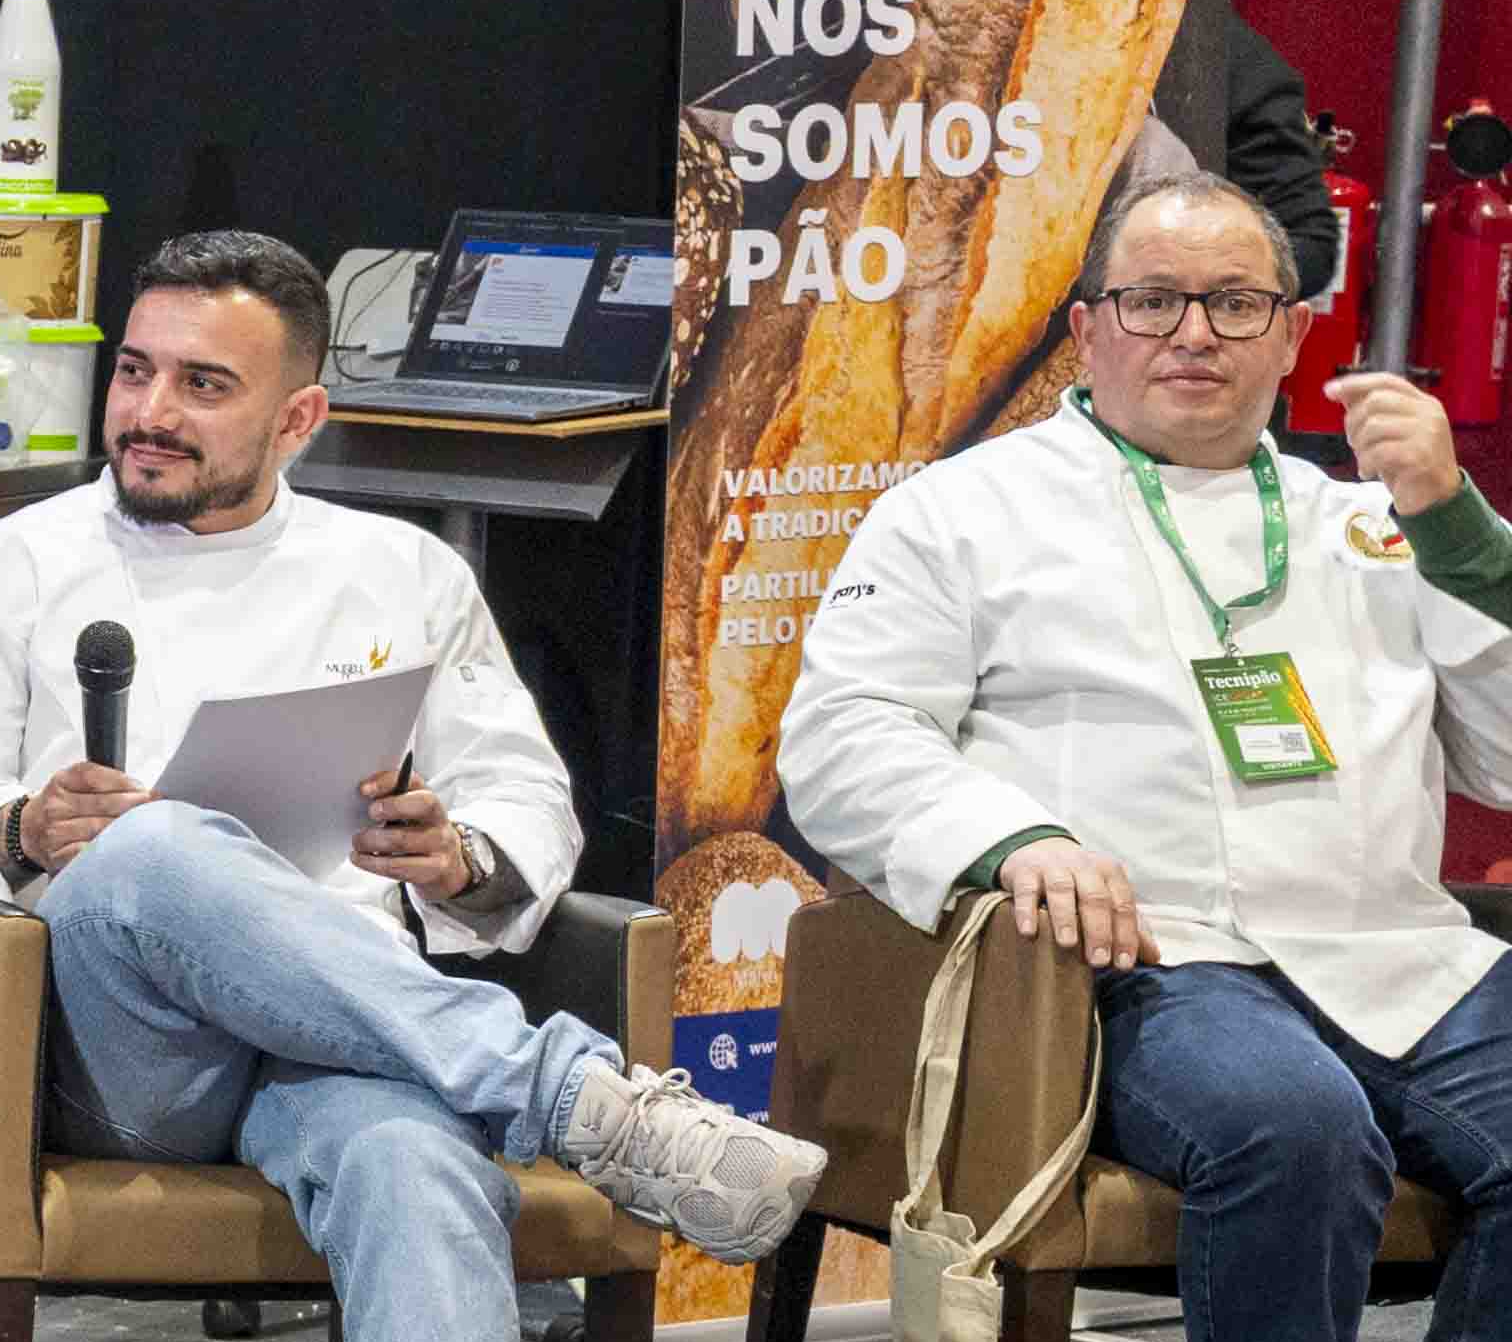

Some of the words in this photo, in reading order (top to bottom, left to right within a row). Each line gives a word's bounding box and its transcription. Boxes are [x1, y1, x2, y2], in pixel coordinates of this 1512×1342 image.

[728, 99, 1045, 182] SOMOS
[726, 207, 908, 308] PÃO
[722, 513, 745, 543] A
[721, 615, 797, 649] PELO
[1203, 669, 1282, 690] Tecnipão
